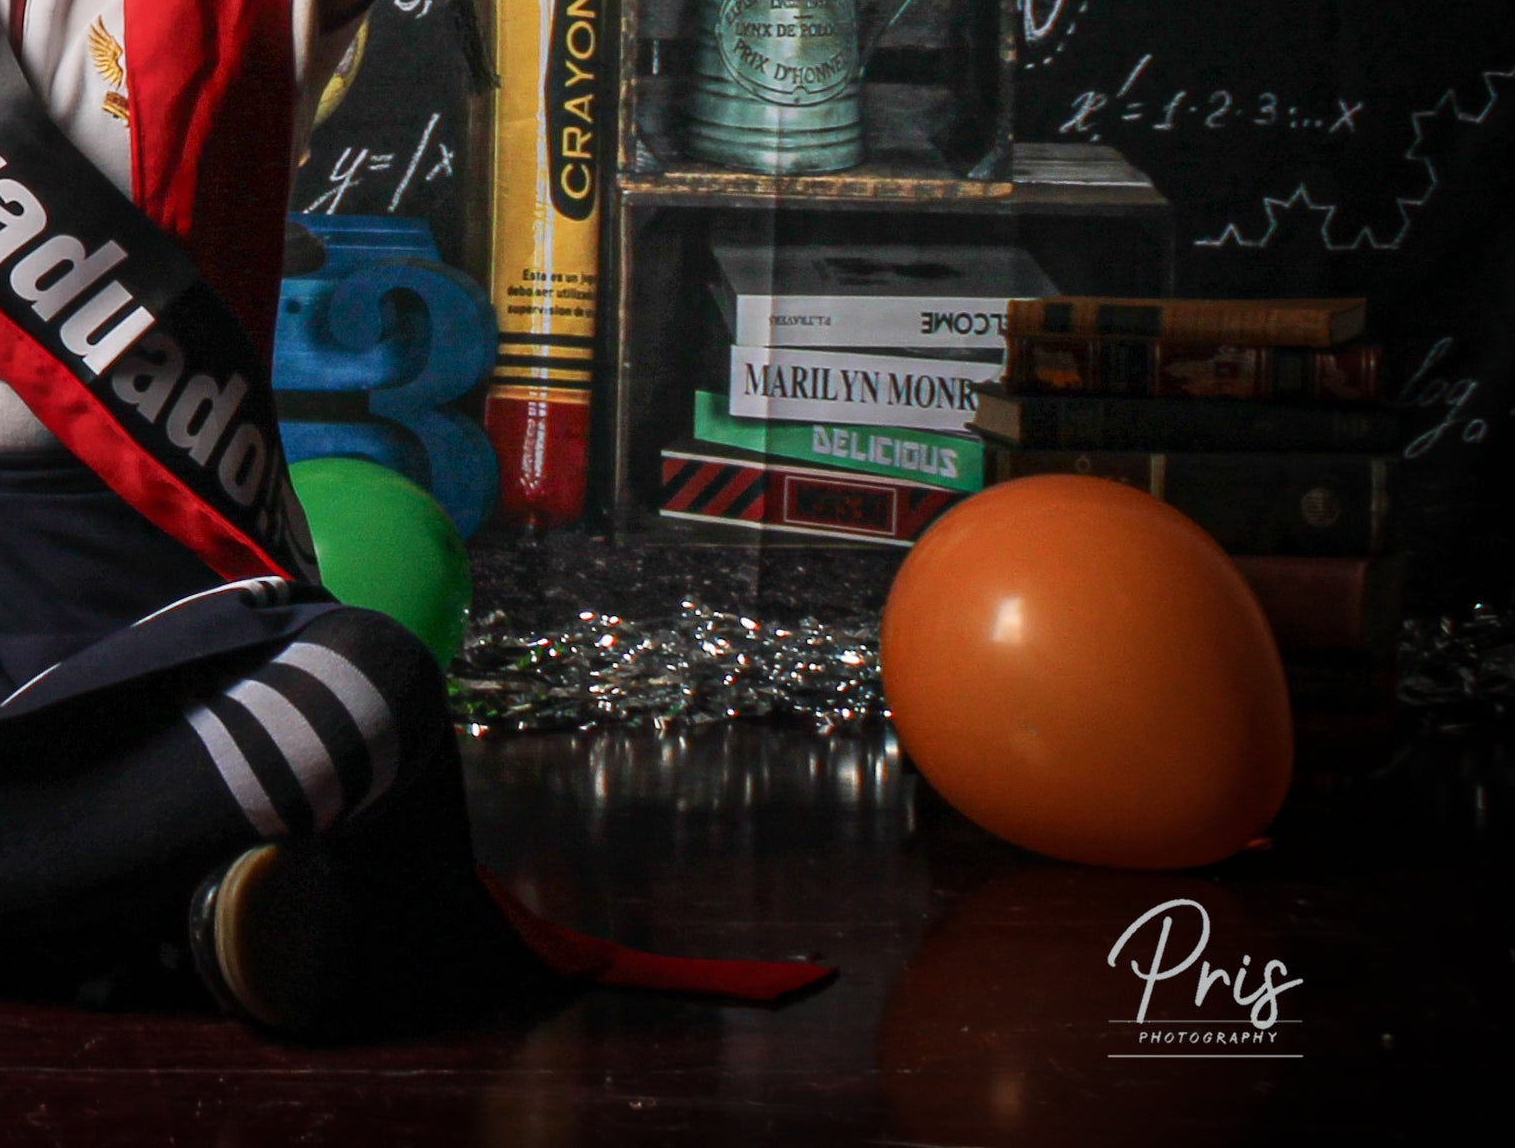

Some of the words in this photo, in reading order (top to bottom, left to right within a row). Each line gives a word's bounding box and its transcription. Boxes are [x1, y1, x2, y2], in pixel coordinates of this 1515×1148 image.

[733, 38, 769, 73] PRIX
[744, 362, 881, 404] MARILYN
[812, 424, 959, 480] DELICIOUS
